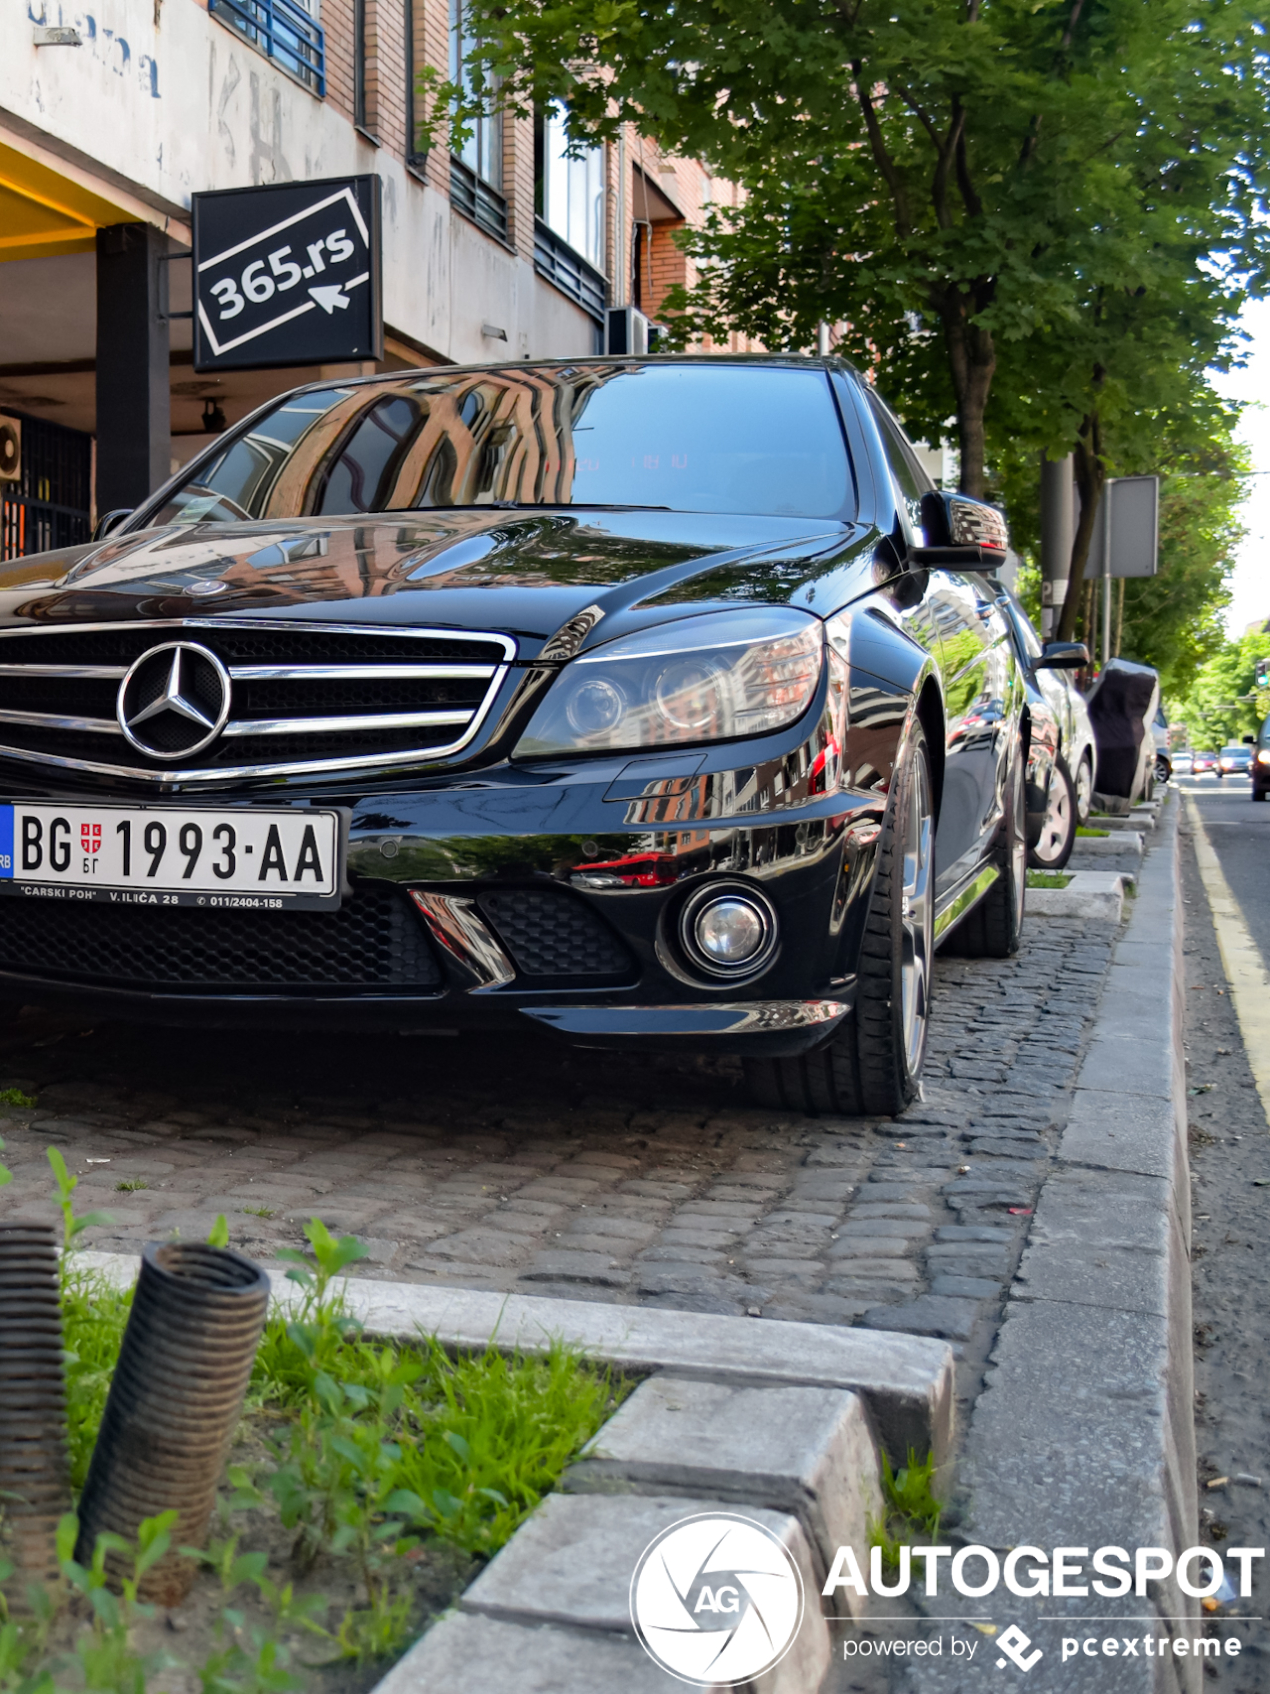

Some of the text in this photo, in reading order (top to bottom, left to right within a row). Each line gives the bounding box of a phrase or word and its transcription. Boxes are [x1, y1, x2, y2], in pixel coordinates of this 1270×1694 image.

[209, 229, 355, 320] 365.rs
[21, 815, 72, 873] BG
[20, 886, 65, 898] "CARSKI
[69, 889, 97, 900] POH"
[162, 895, 179, 905] 28
[210, 897, 283, 909] 011/2404-158
